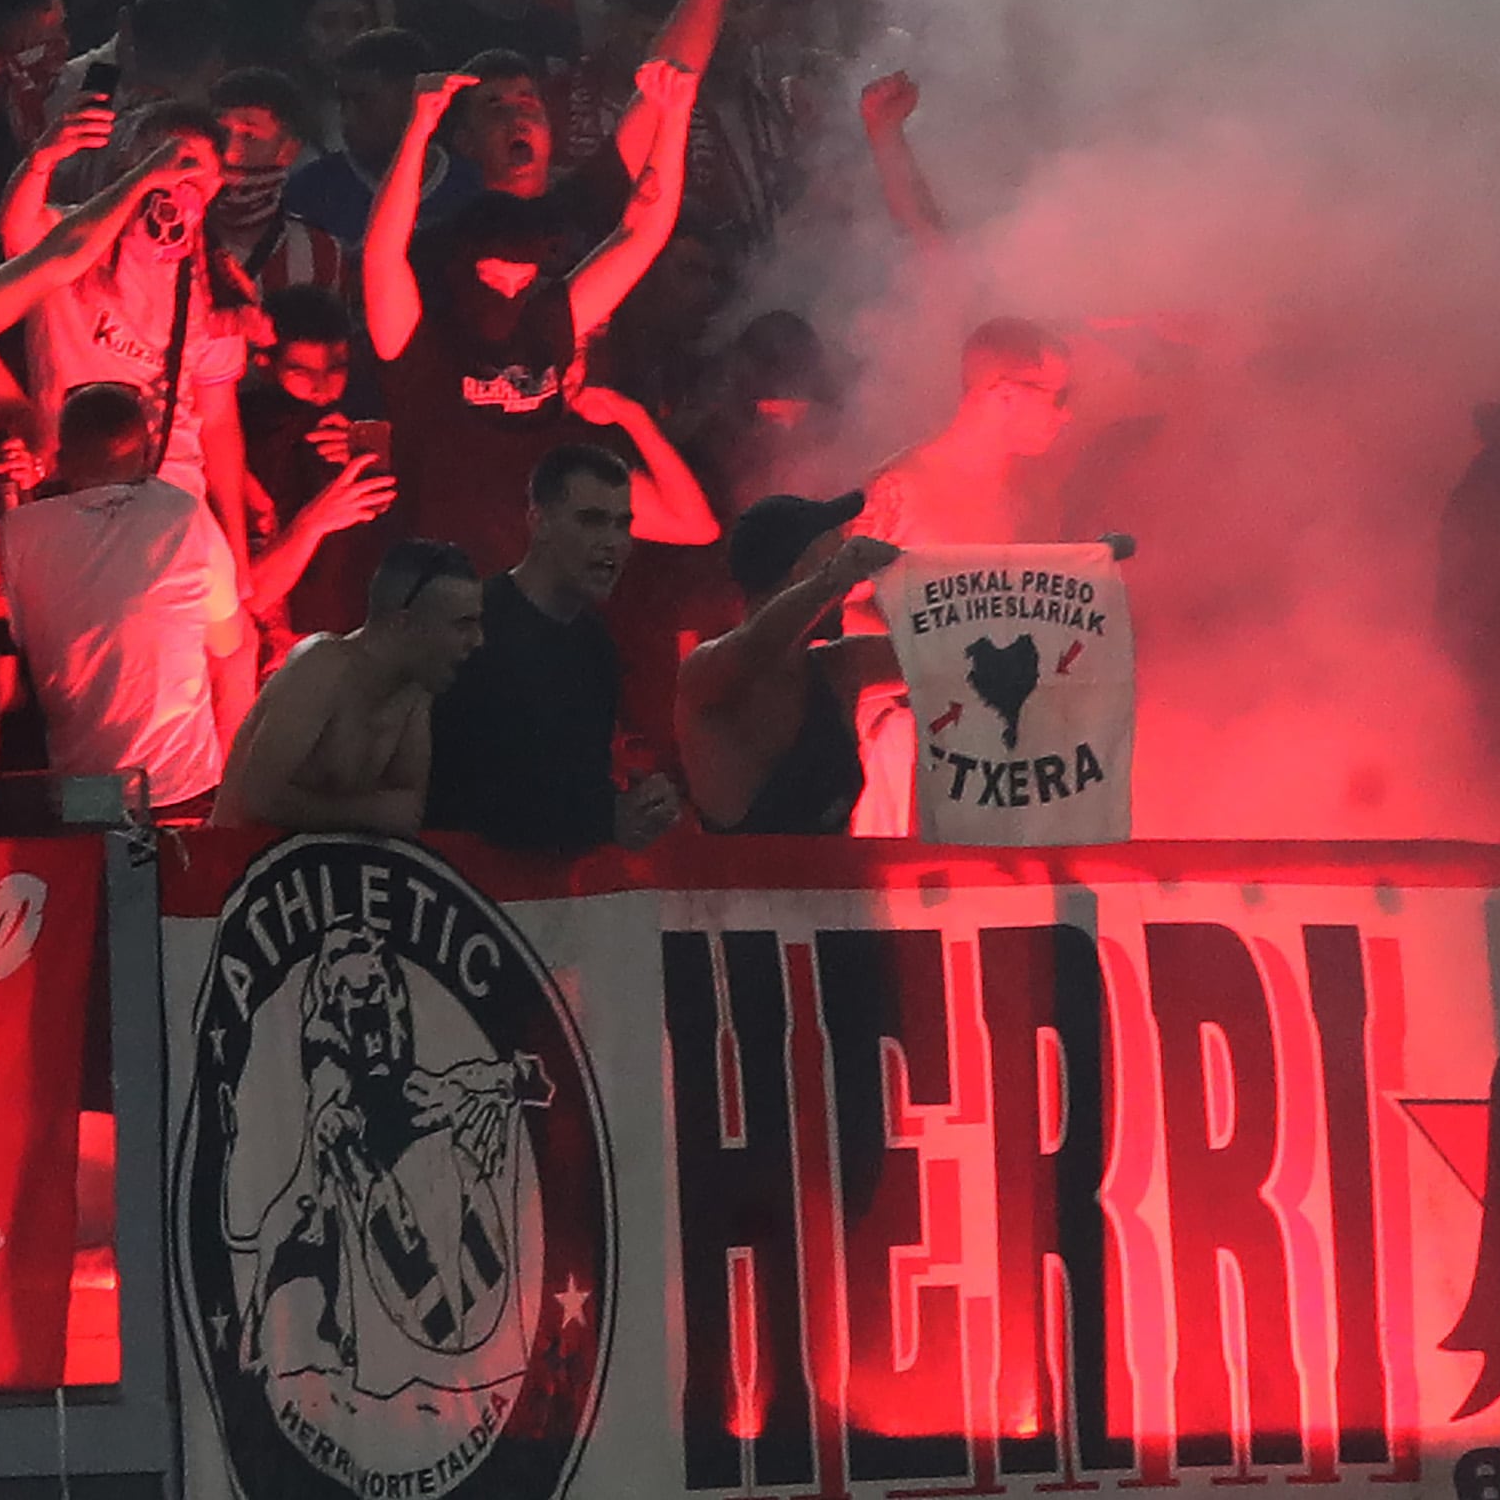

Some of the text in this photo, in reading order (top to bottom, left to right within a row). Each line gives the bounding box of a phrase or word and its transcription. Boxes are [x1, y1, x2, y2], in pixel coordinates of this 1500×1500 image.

[912, 596, 1107, 635] ETA IHESLARIAK
[925, 571, 1095, 605] EUSKAL PRESO
[219, 863, 502, 1022] ATHLETIC
[661, 920, 1412, 1494] HERRI
[279, 1399, 355, 1484] HERR
